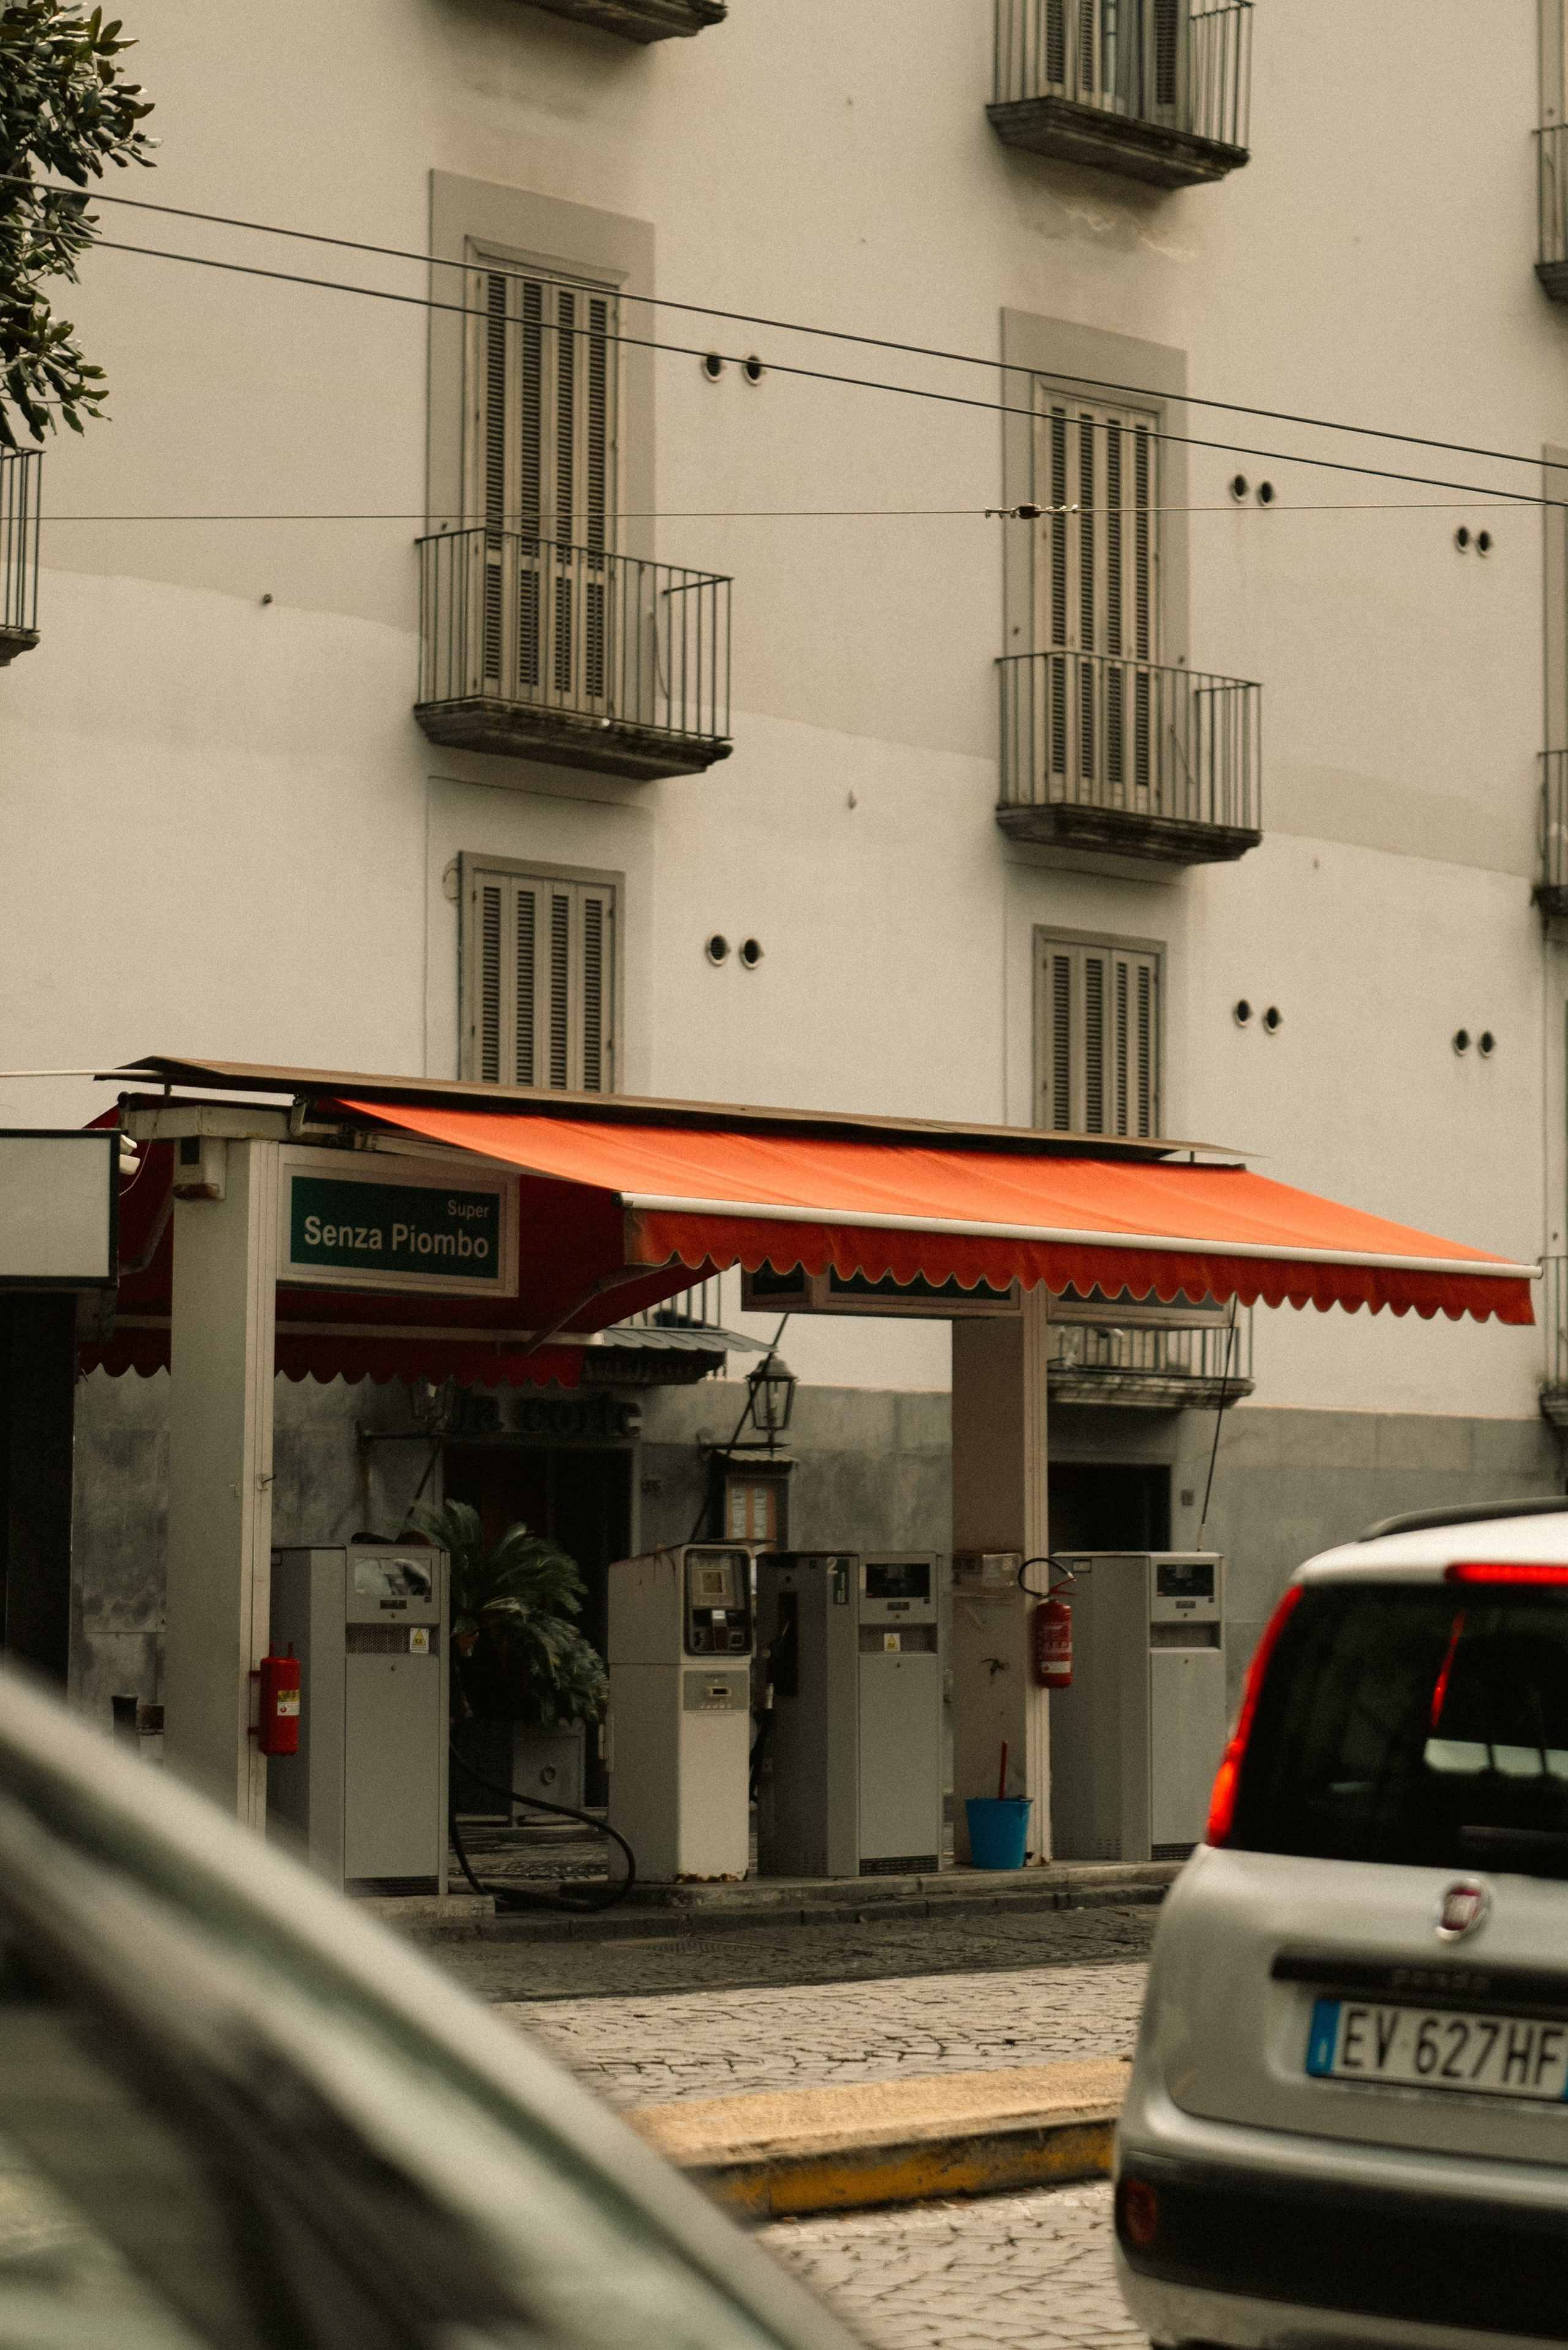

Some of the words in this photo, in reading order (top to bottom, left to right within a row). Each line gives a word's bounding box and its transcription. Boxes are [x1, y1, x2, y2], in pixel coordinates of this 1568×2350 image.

[447, 1199, 489, 1220] Super
[304, 1215, 383, 1251] Senza
[391, 1223, 489, 1258] Piombo
[826, 1556, 839, 1575] 2
[1342, 2008, 1400, 2068] EV
[1414, 2017, 1564, 2085] 627HF
